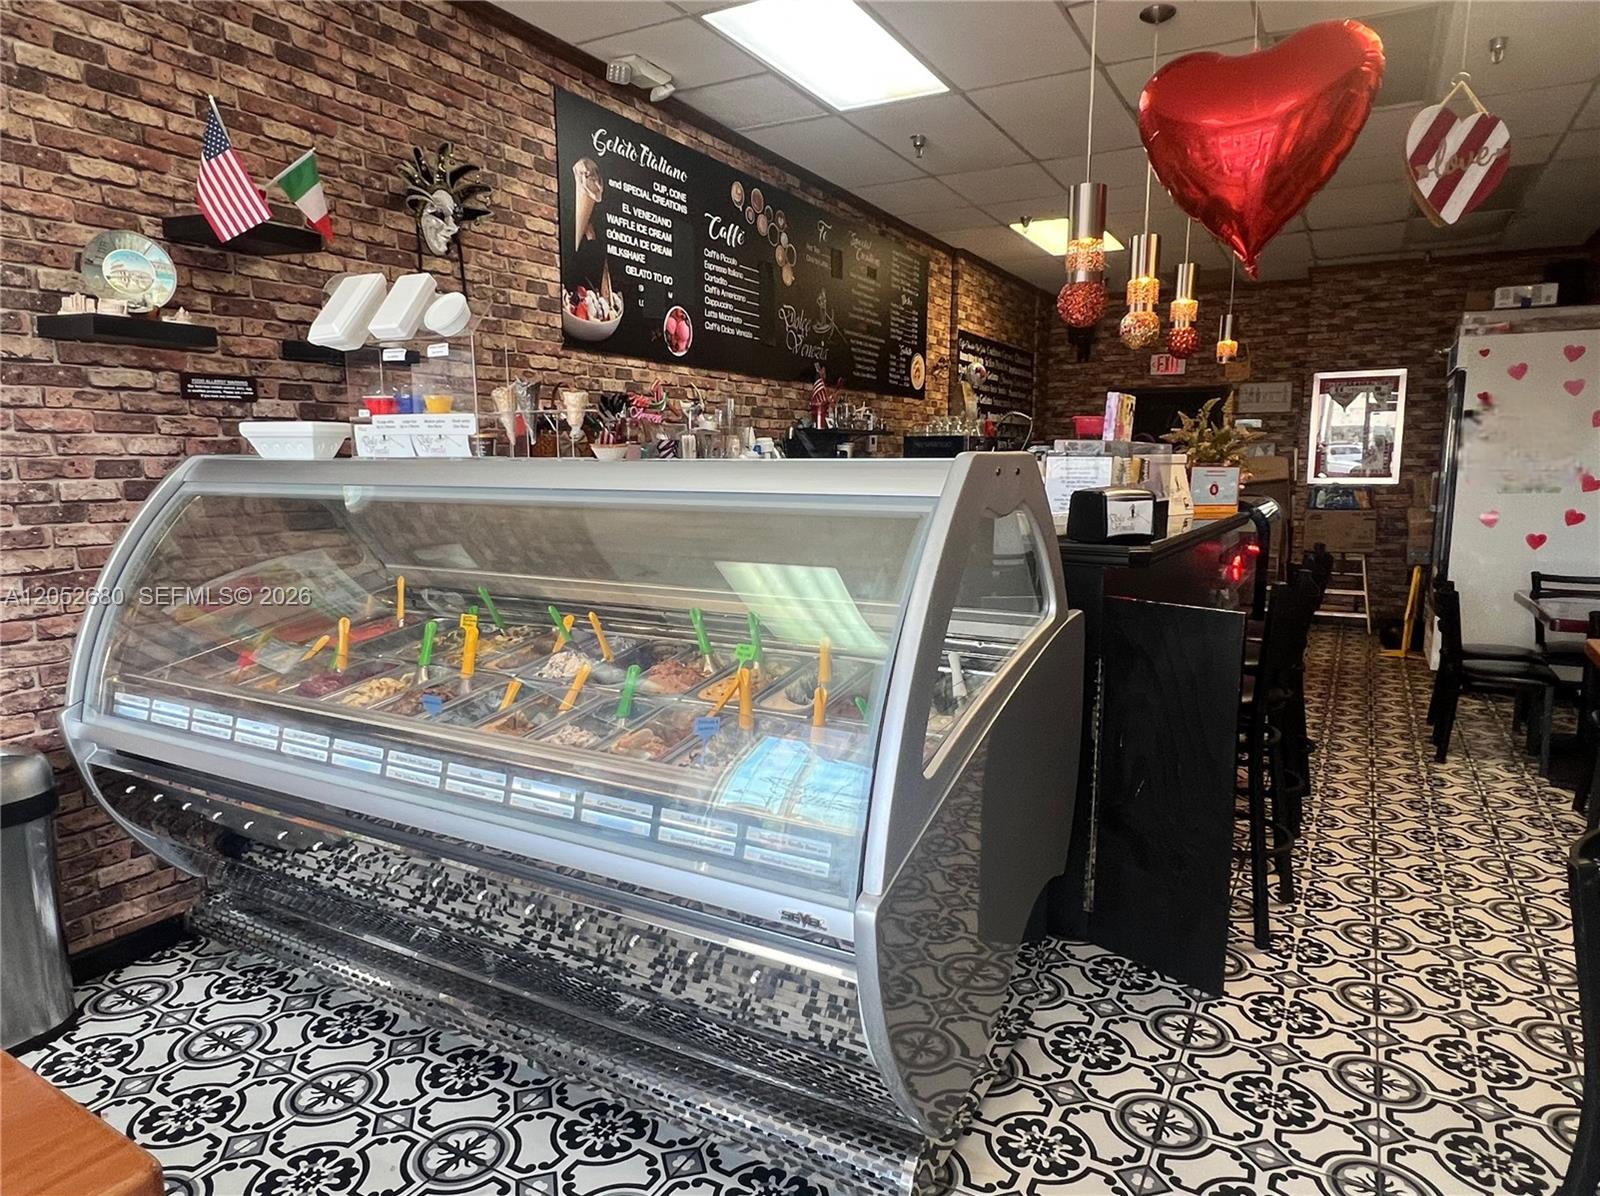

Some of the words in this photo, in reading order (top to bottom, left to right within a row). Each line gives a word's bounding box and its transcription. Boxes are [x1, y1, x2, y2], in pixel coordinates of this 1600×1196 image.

[591, 128, 638, 162] Gelato
[640, 143, 688, 183] Italiano
[608, 179, 622, 190] and
[622, 182, 652, 202] SPECIAL
[652, 193, 688, 215] CREATIONS
[669, 188, 687, 203] CONE
[606, 212, 636, 232] WAFFLE
[636, 222, 649, 236] ICE
[648, 227, 673, 243] CREAM
[622, 202, 632, 215] EL
[632, 206, 672, 229] VENEZIANO
[606, 243, 646, 264] MILKSHAKE
[639, 238, 650, 251] ICE
[650, 242, 673, 258] CREAM
[625, 264, 653, 281] GELATO
[653, 271, 663, 283] TO
[663, 275, 673, 286] GO
